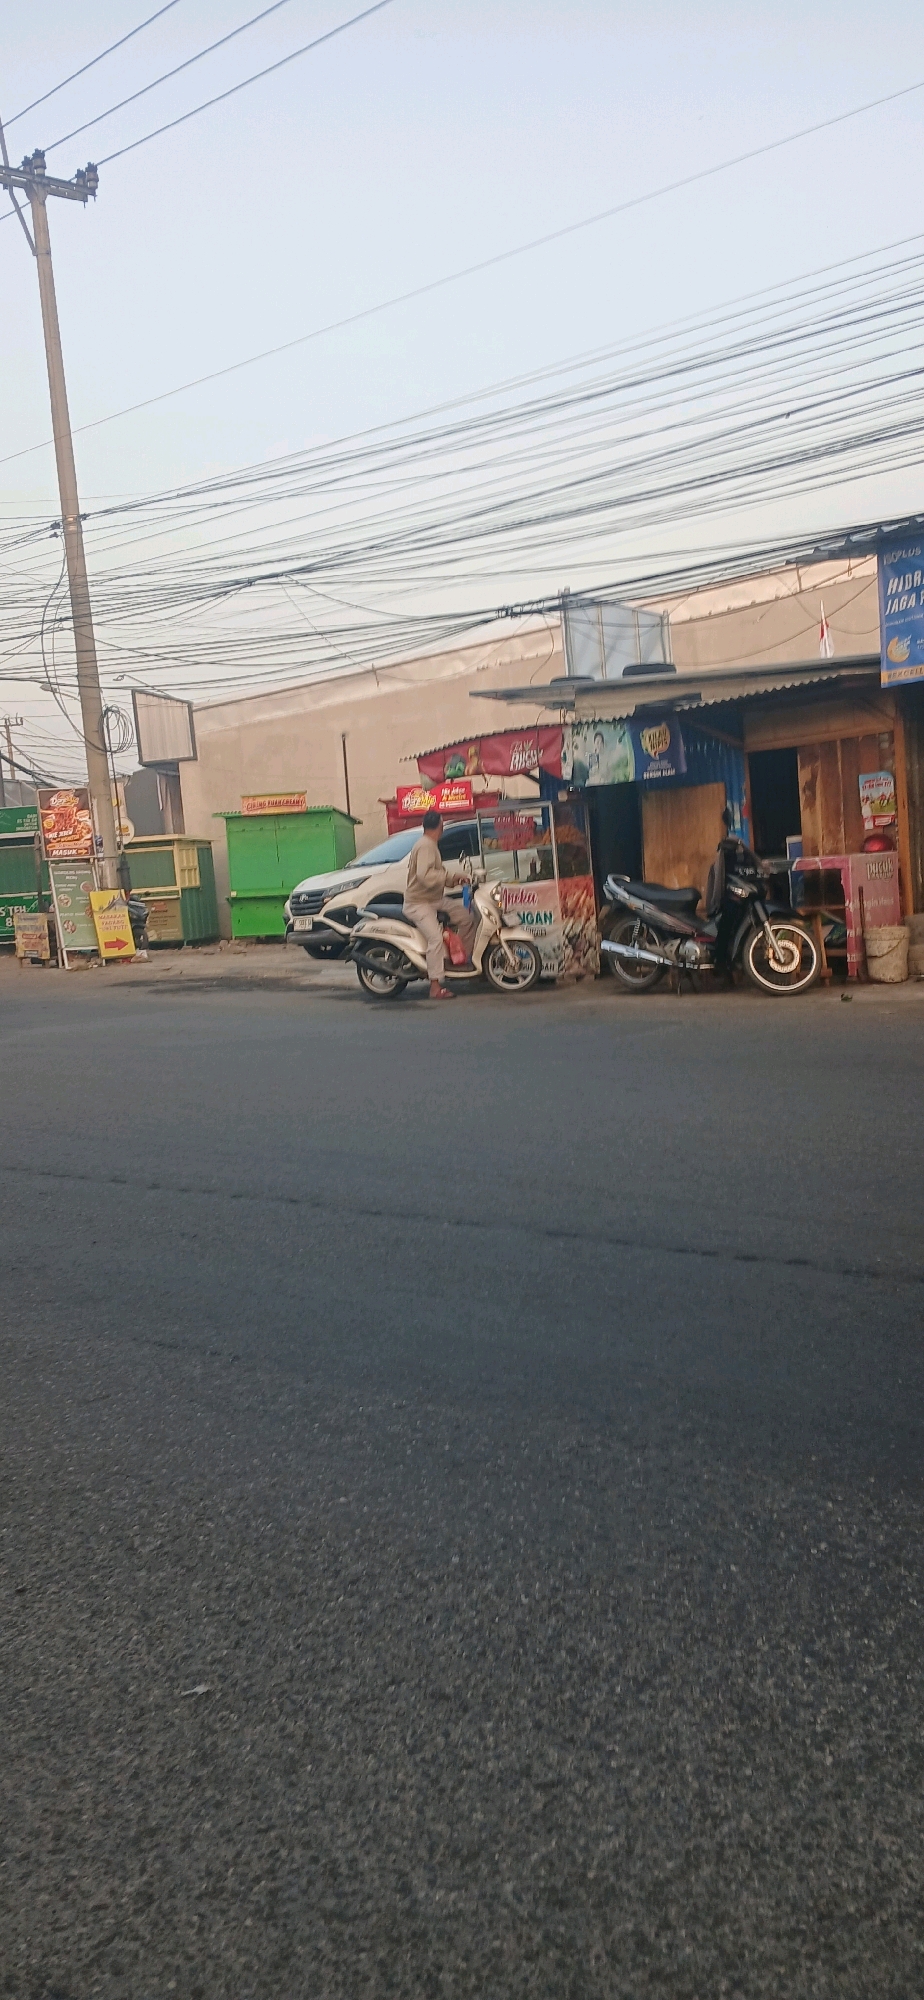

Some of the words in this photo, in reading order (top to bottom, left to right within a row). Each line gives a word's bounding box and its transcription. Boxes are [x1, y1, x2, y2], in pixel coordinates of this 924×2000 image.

[887, 570, 924, 596] HIDR
[885, 592, 916, 616] JAGA
[52, 848, 78, 856] MASUK
[517, 911, 553, 925] NGAN
